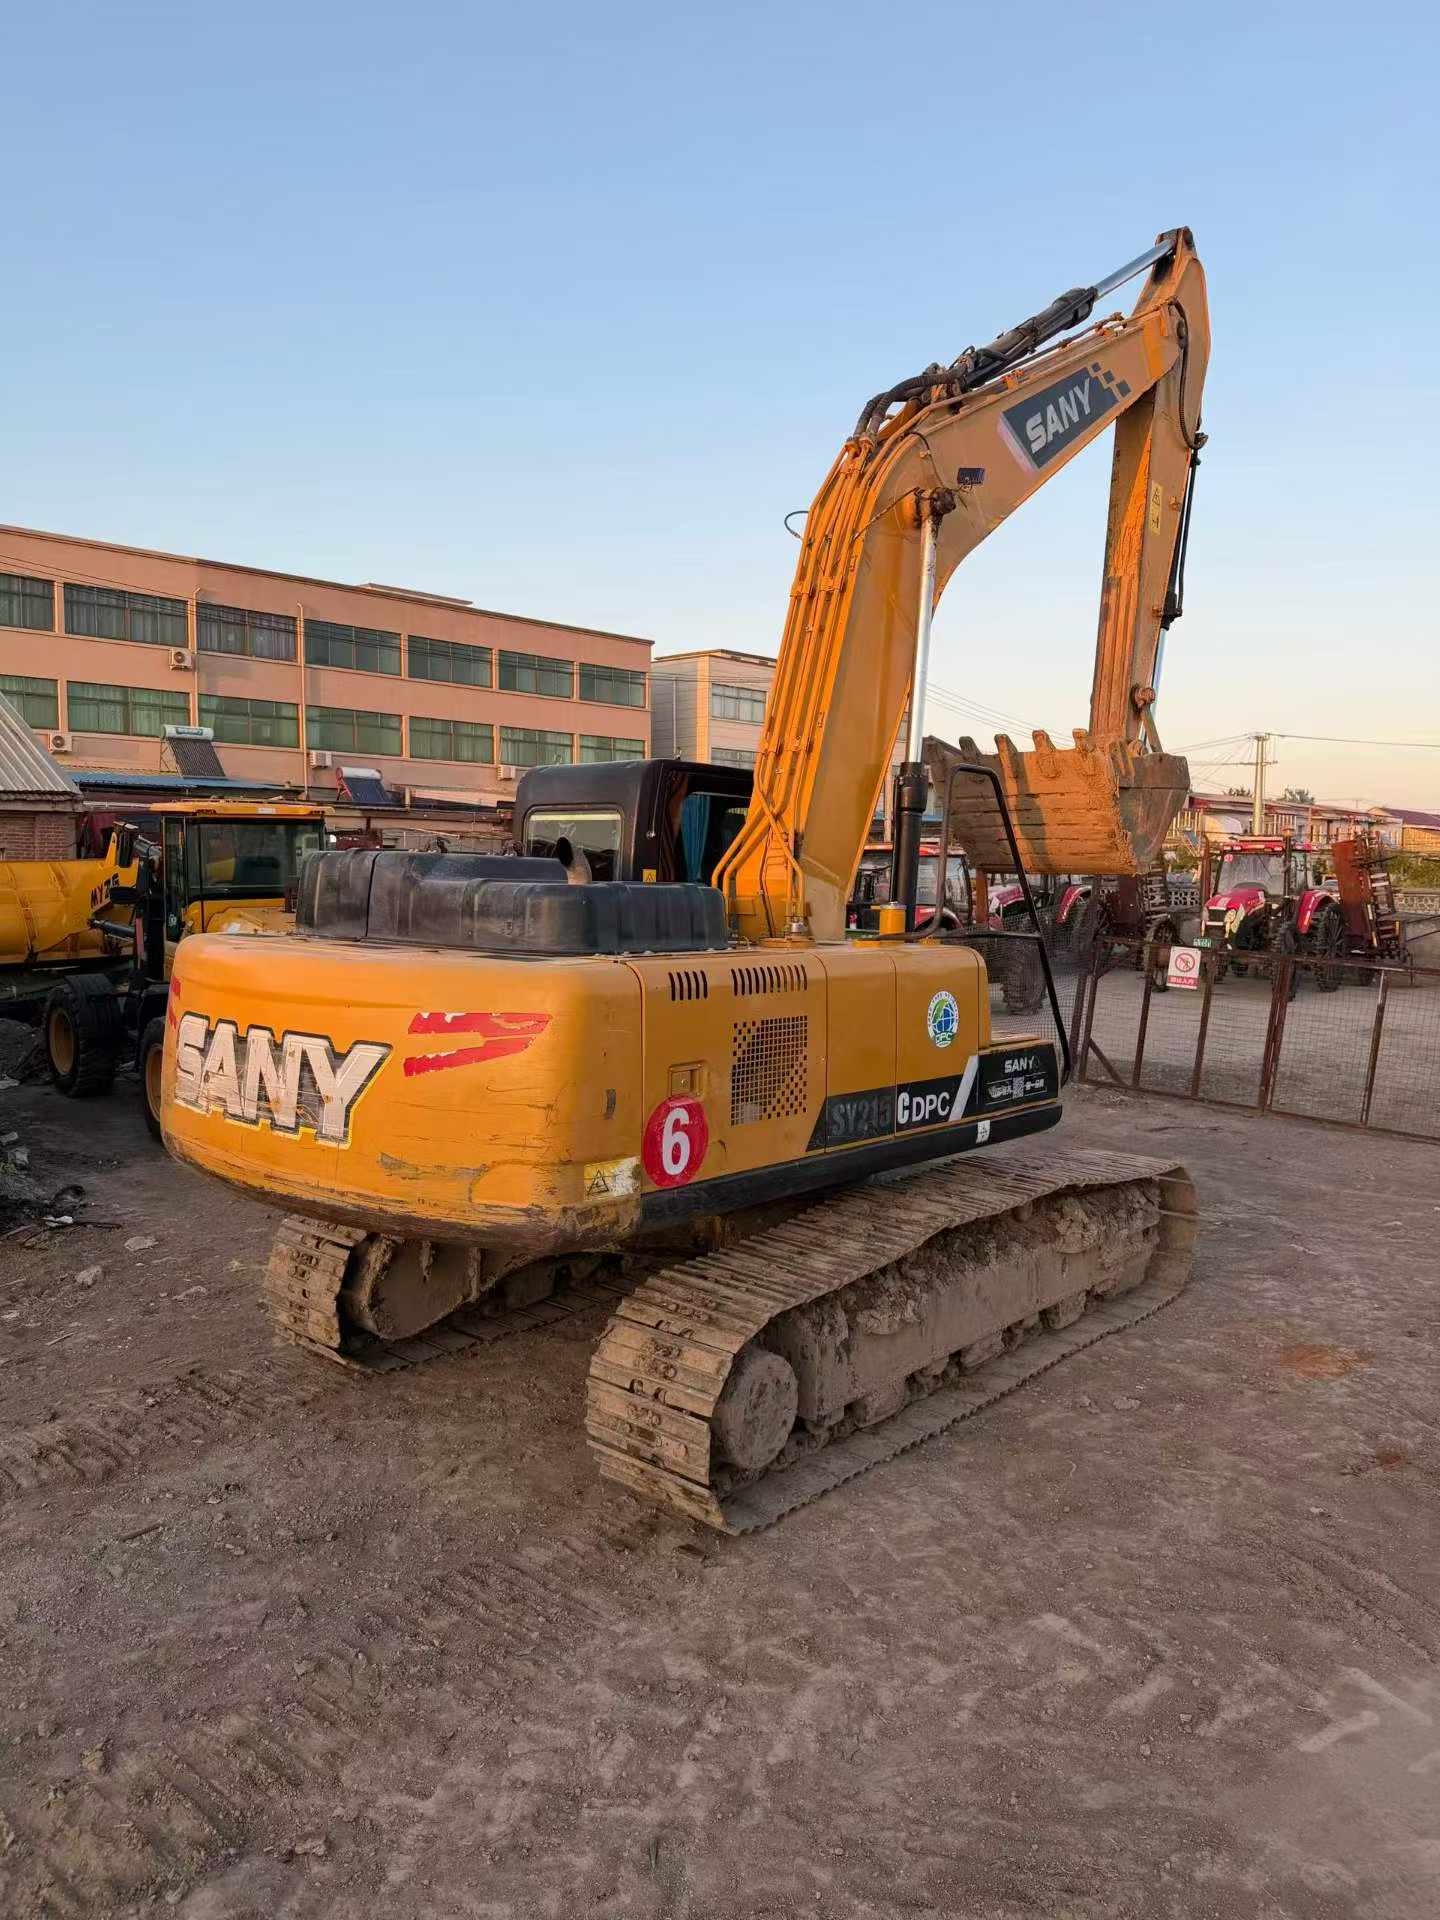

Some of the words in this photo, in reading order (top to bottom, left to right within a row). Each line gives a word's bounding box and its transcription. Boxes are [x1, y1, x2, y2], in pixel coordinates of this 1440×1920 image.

[1026, 378, 1090, 454] SANY
[175, 1011, 393, 1149] SANY
[1004, 1055, 1035, 1073] SANY
[662, 1107, 691, 1176] 6
